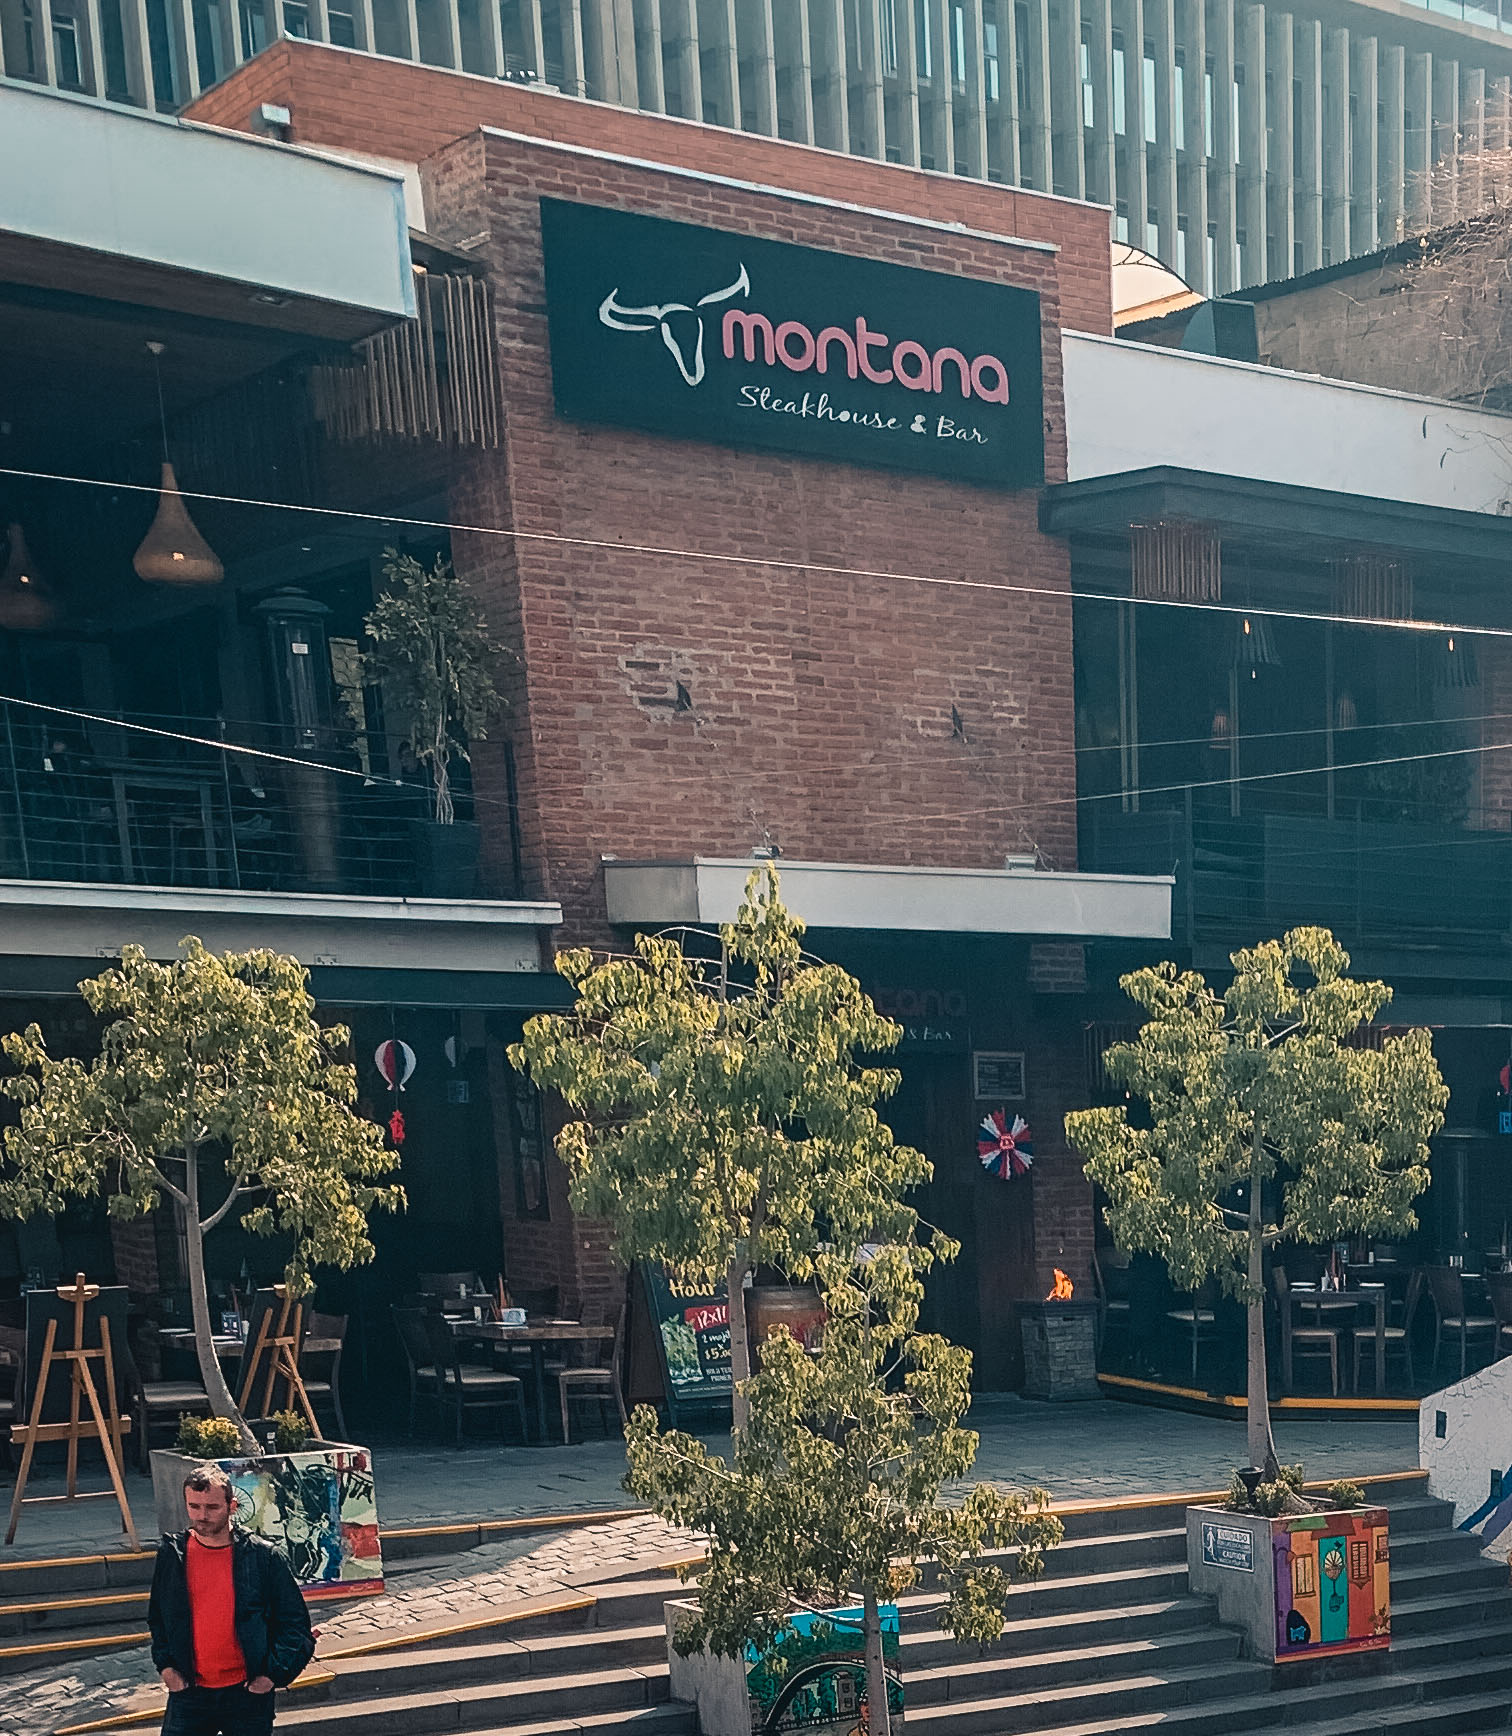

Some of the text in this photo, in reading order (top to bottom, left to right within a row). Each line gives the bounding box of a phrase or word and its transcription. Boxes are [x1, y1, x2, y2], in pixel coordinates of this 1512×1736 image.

[722, 309, 1009, 405] montana
[736, 384, 989, 445] Steakhouse & Bar
[668, 1278, 715, 1298] Hour
